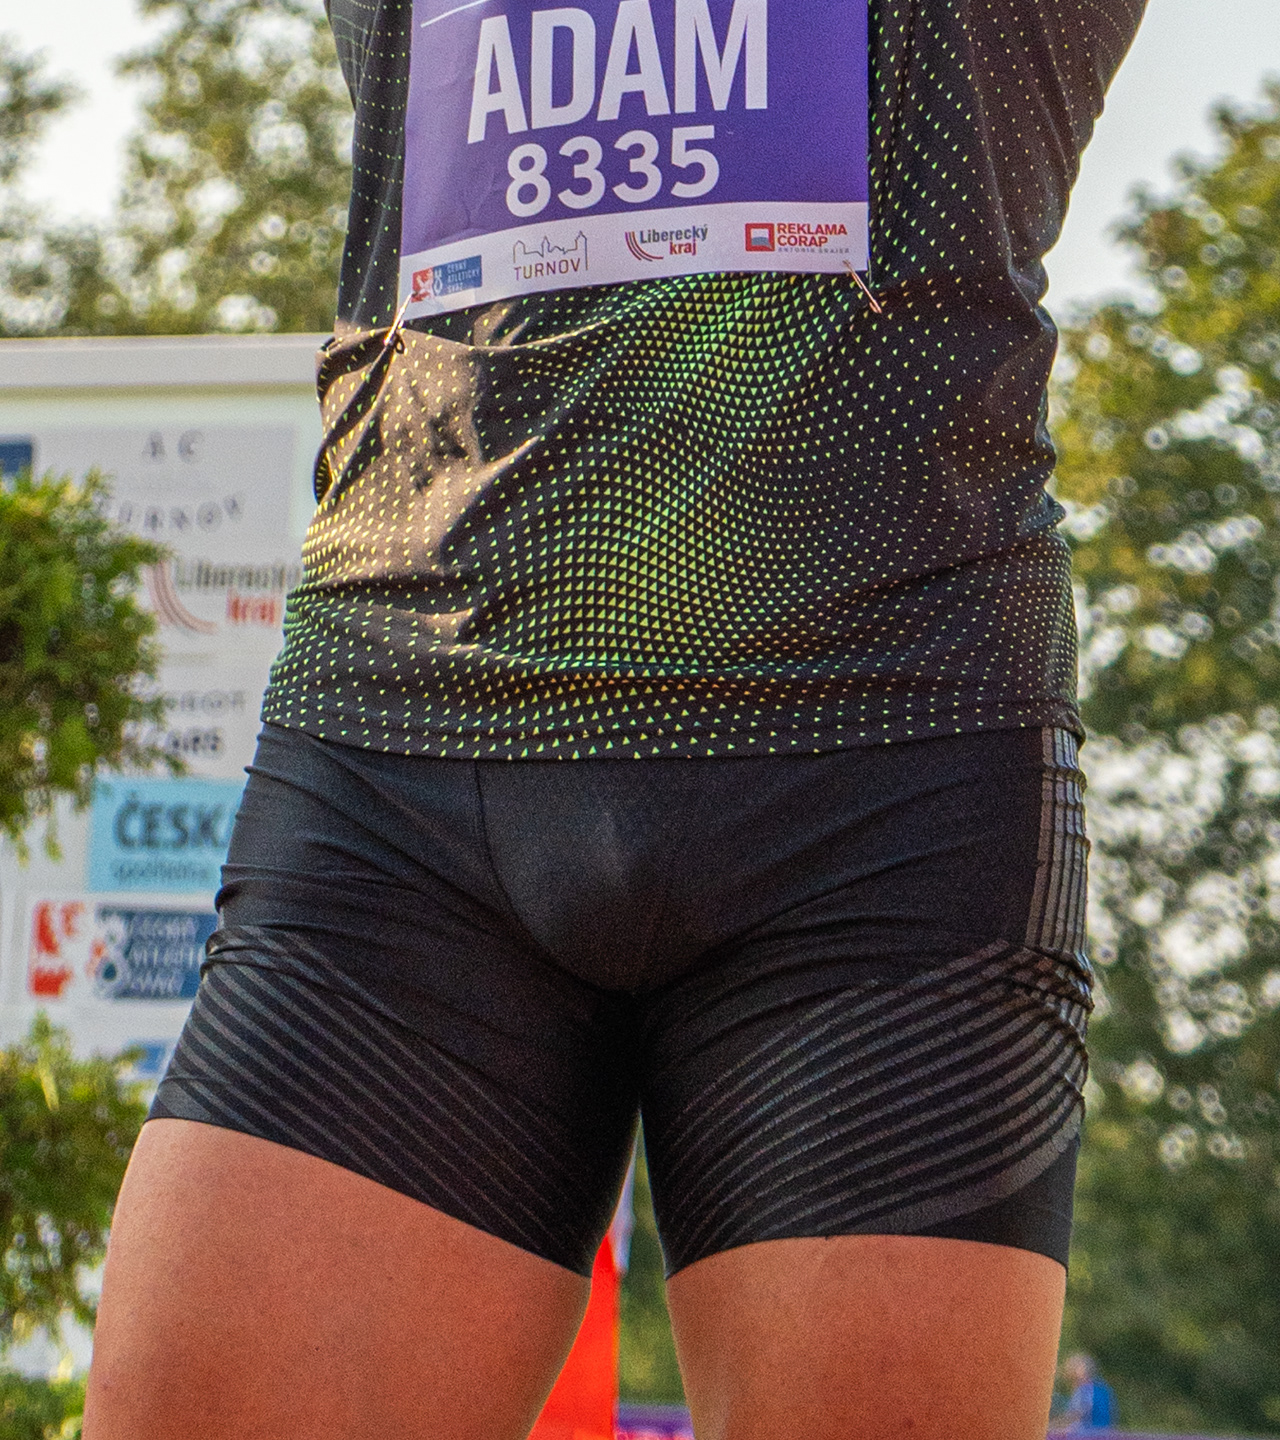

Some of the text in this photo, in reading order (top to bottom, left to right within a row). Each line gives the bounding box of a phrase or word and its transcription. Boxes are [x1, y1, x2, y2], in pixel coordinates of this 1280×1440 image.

[505, 125, 720, 218] 8335
[639, 224, 709, 244] Liberecký
[776, 223, 848, 236] REKLAMA
[669, 240, 698, 256] kraj
[777, 234, 829, 248] CORAP
[513, 258, 581, 281] TURNOV
[114, 789, 228, 849] ČESK
